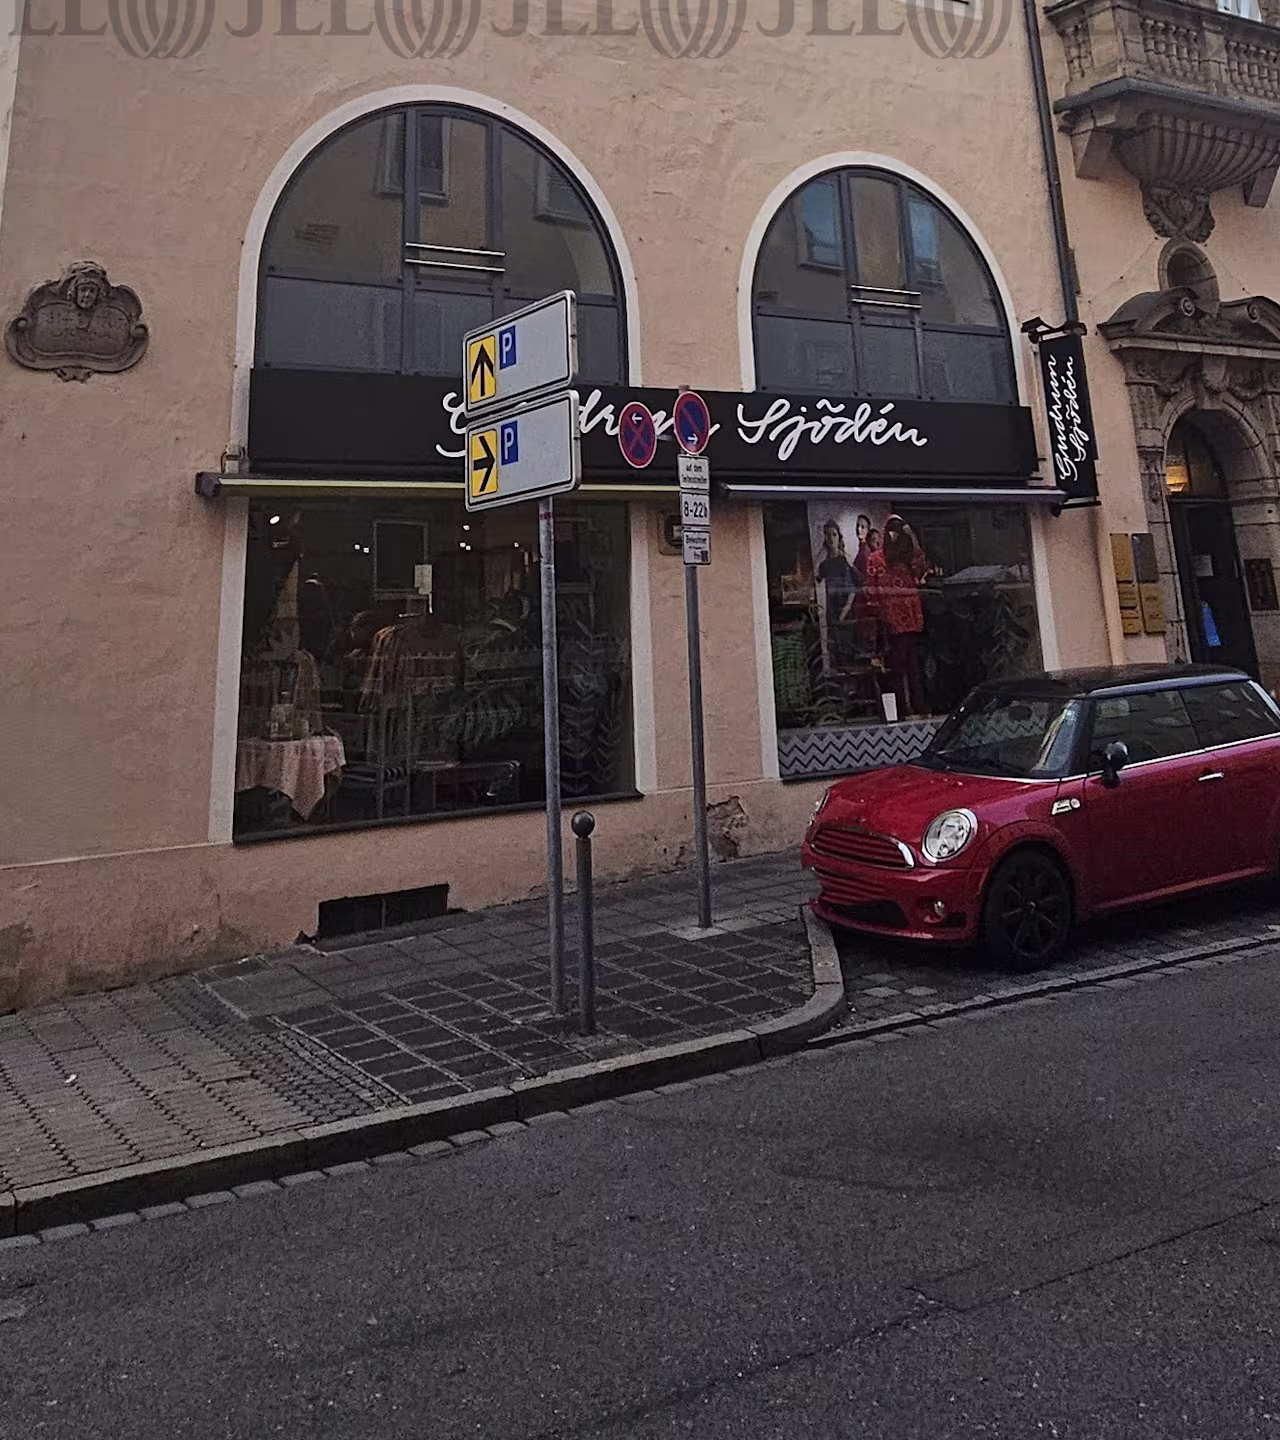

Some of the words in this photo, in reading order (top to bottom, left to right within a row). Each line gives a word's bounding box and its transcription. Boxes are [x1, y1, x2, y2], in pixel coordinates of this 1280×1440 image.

[502, 333, 513, 364] P
[1048, 354, 1078, 482] Gudrun
[504, 427, 515, 458] P
